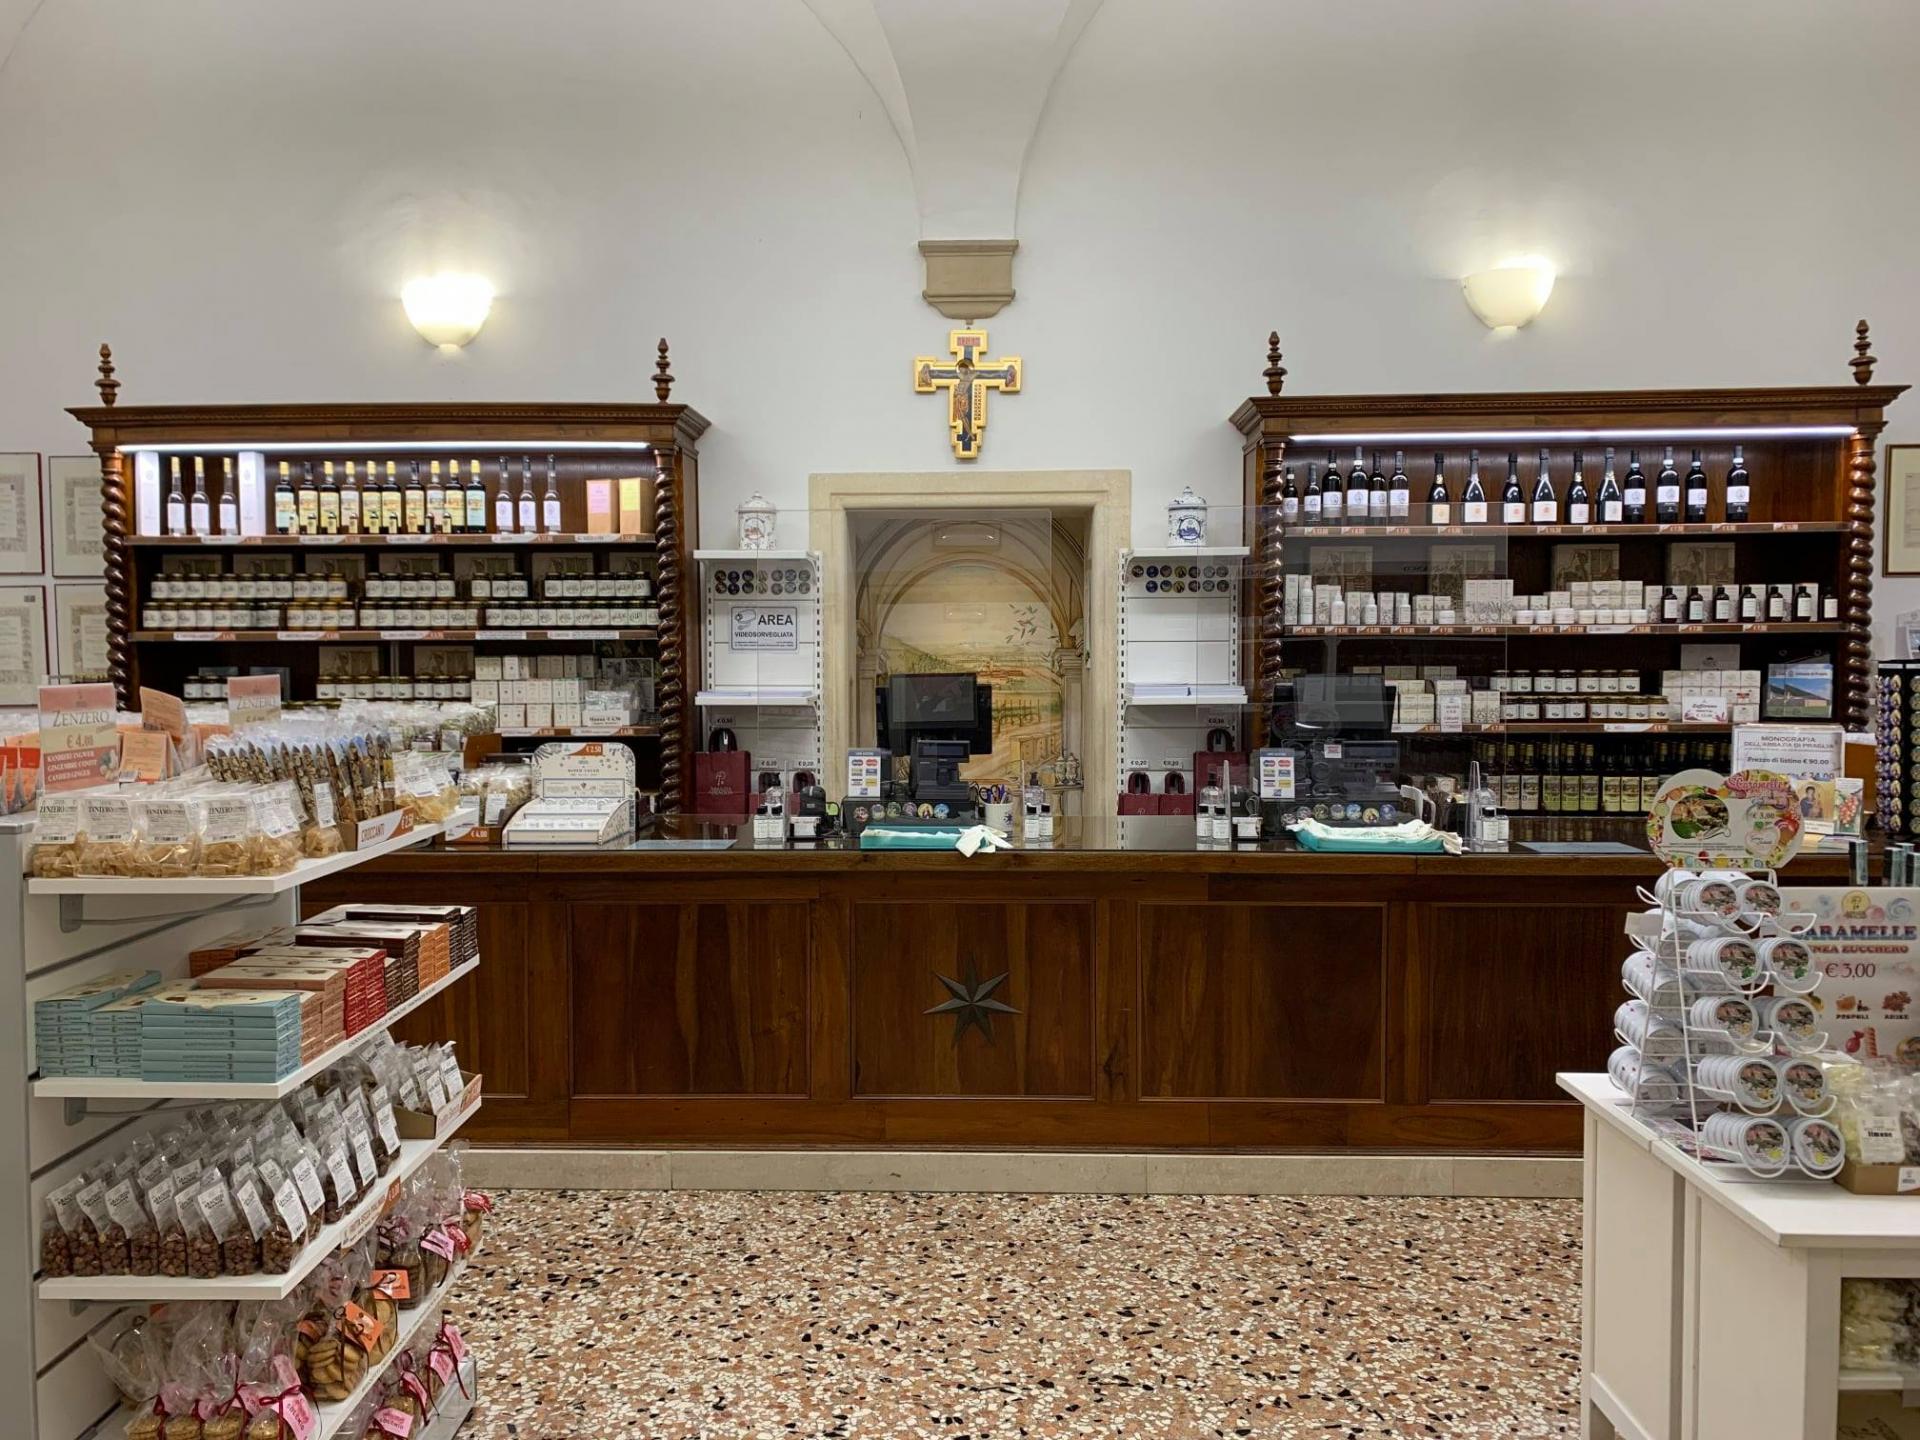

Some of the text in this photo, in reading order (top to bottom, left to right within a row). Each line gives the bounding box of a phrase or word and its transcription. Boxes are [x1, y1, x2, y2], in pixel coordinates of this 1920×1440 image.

[758, 614, 794, 626] AREA
[52, 710, 111, 728] ZENZERO
[1760, 735, 1817, 743] MONOGRAFIA
[1791, 925, 1917, 941] CARAMELLE
[1842, 945, 1909, 954] ZUCCHERO
[1825, 963, 1839, 978] €
